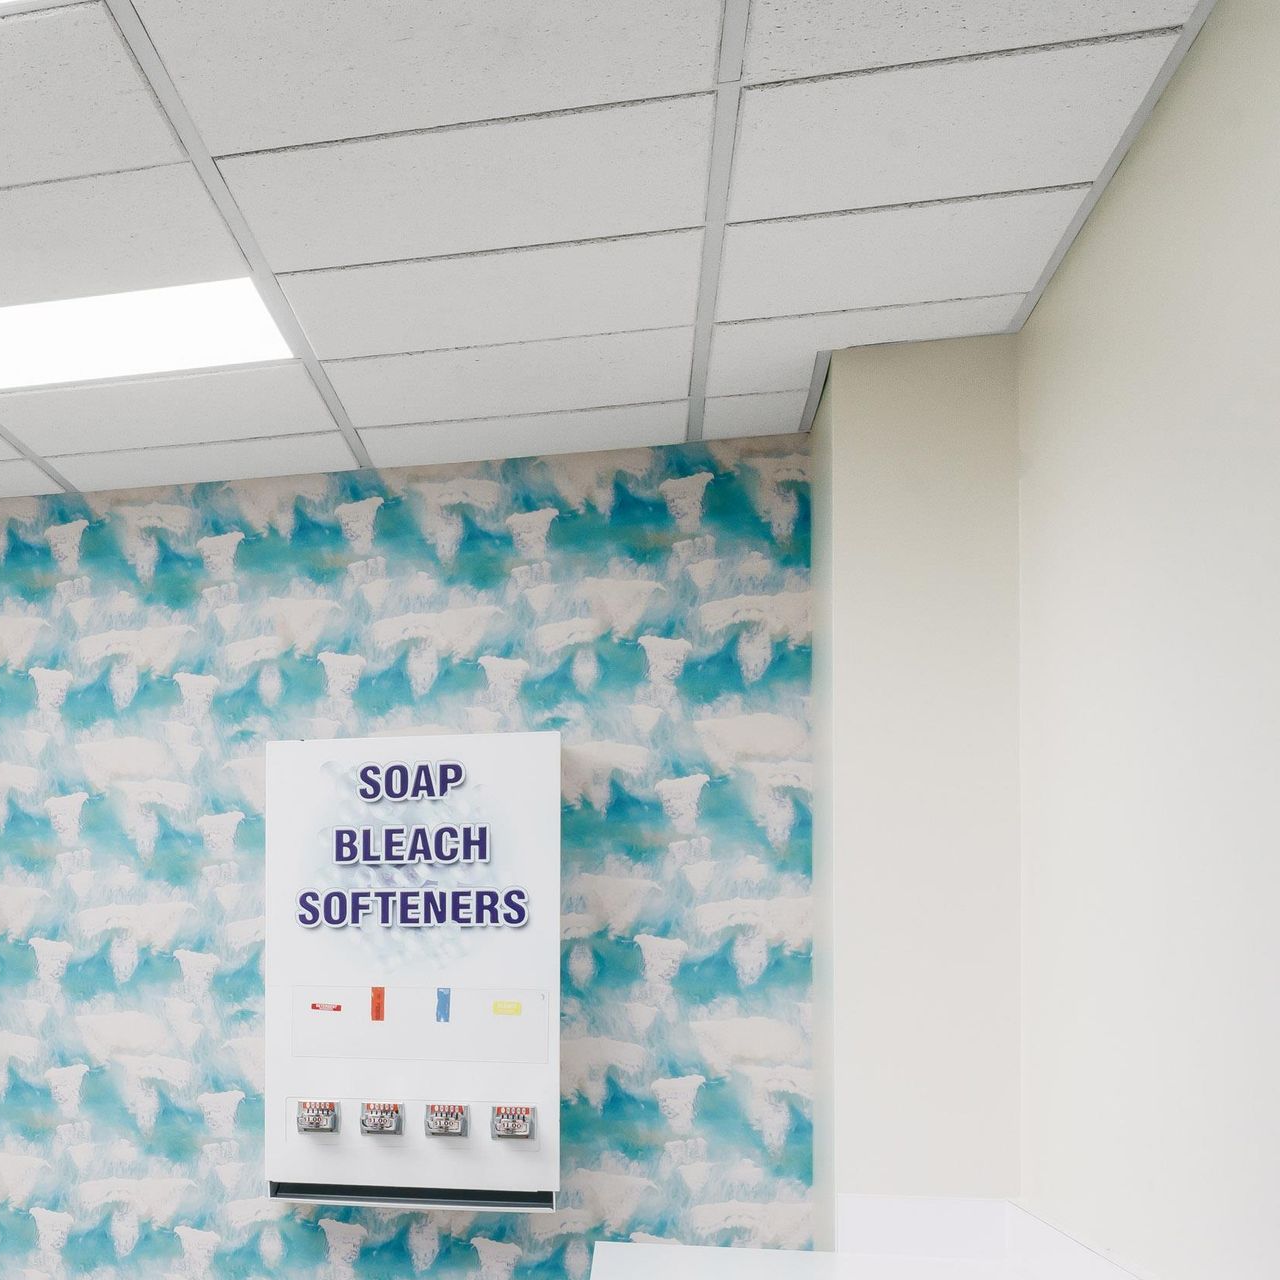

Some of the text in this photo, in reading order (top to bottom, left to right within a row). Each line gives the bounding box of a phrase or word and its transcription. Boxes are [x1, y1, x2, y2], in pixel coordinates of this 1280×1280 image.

[357, 762, 464, 801] SOAP
[334, 825, 488, 863] BLEACH
[297, 888, 527, 926] SOFTENERS
